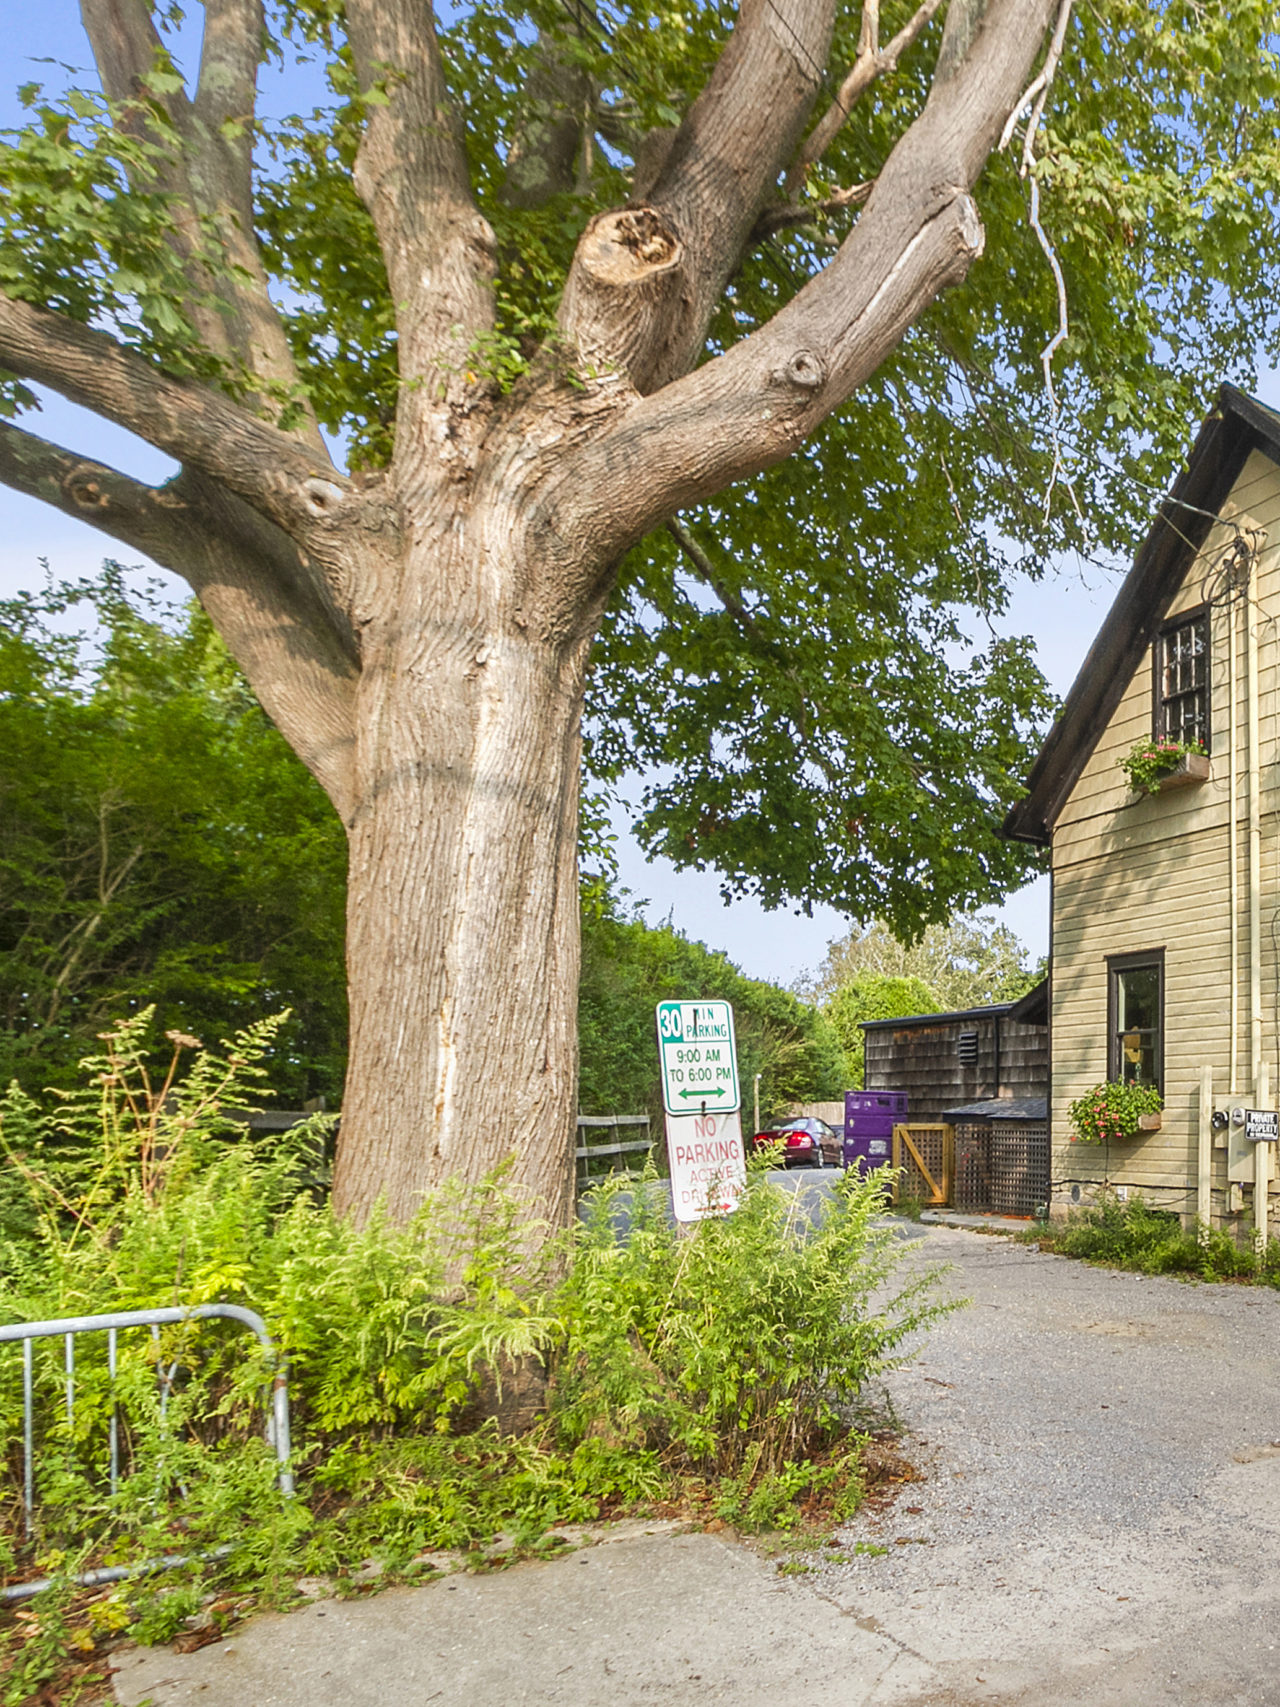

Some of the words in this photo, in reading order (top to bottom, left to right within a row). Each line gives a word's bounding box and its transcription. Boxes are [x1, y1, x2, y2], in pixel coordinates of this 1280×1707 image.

[660, 1009, 681, 1038] 30
[686, 1023, 727, 1038] PARKING
[677, 1049, 701, 1063] 9:00
[705, 1049, 720, 1062] AM
[669, 1069, 684, 1082] TO
[688, 1067, 712, 1082] 6:00
[716, 1067, 731, 1080] PM
[694, 1116, 716, 1138] NO
[1247, 1123, 1278, 1133] PROPERTY
[676, 1140, 739, 1165] PARKING
